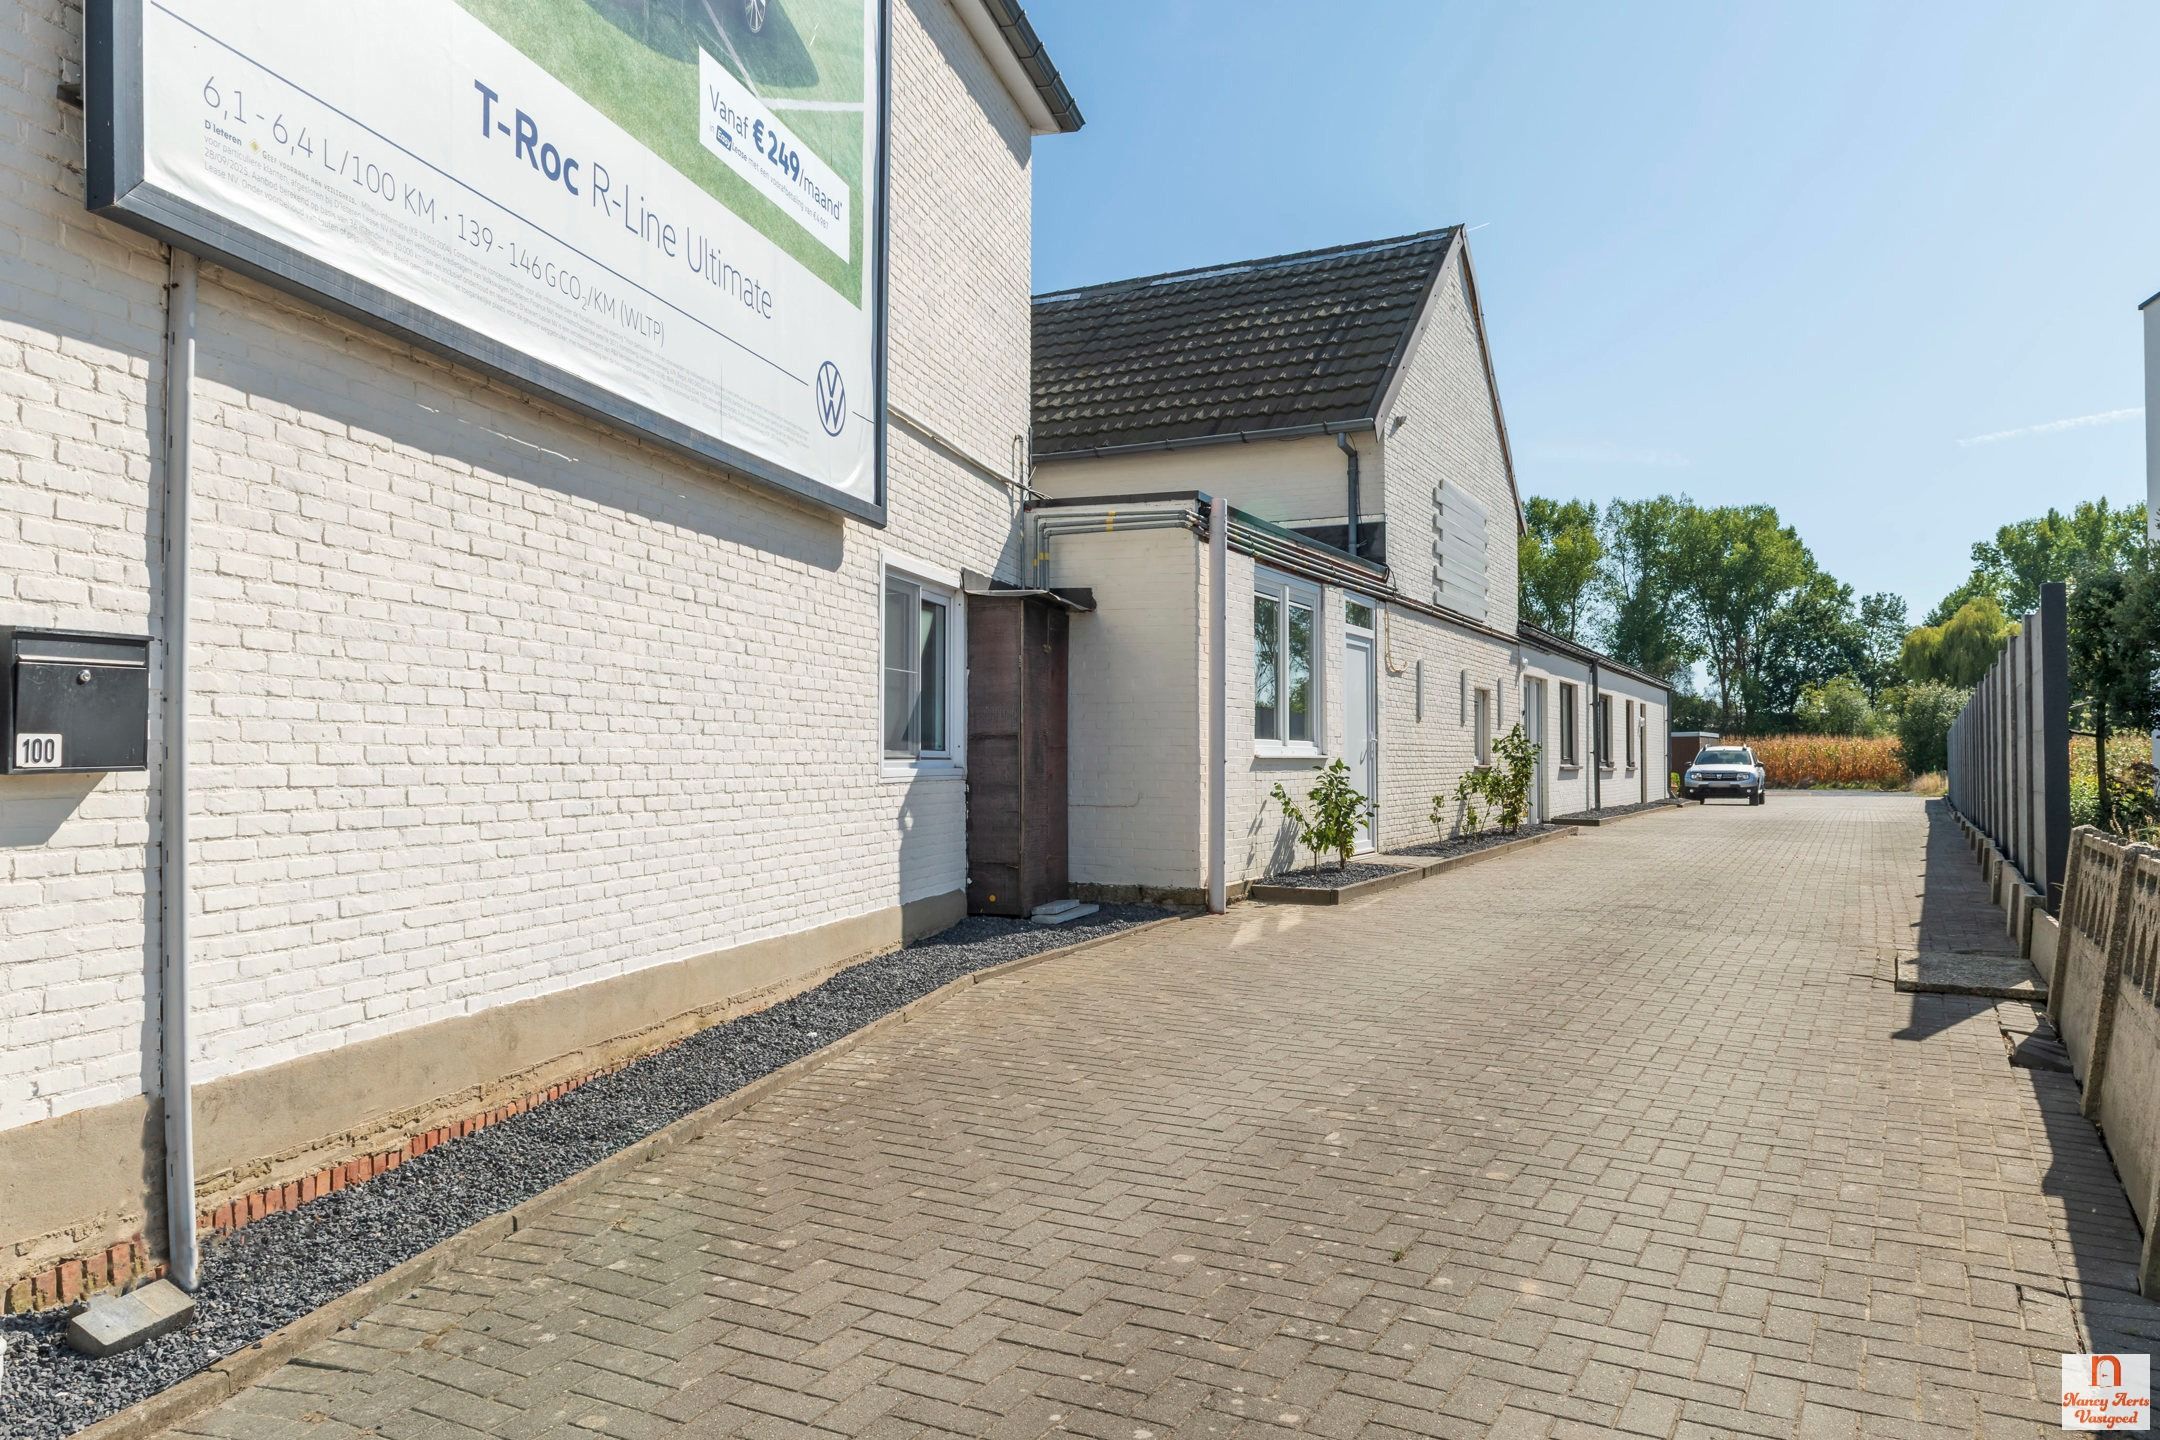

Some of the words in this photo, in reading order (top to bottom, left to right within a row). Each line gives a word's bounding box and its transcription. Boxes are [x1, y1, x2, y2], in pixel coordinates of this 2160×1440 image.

[709, 84, 748, 139] Vanaf
[474, 79, 579, 196] T-Roc
[593, 162, 676, 257] R-Line
[687, 226, 772, 319] Ultimate
[404, 184, 435, 224] KM
[620, 300, 665, 347] (WLTP)
[22, 738, 55, 763] 100
